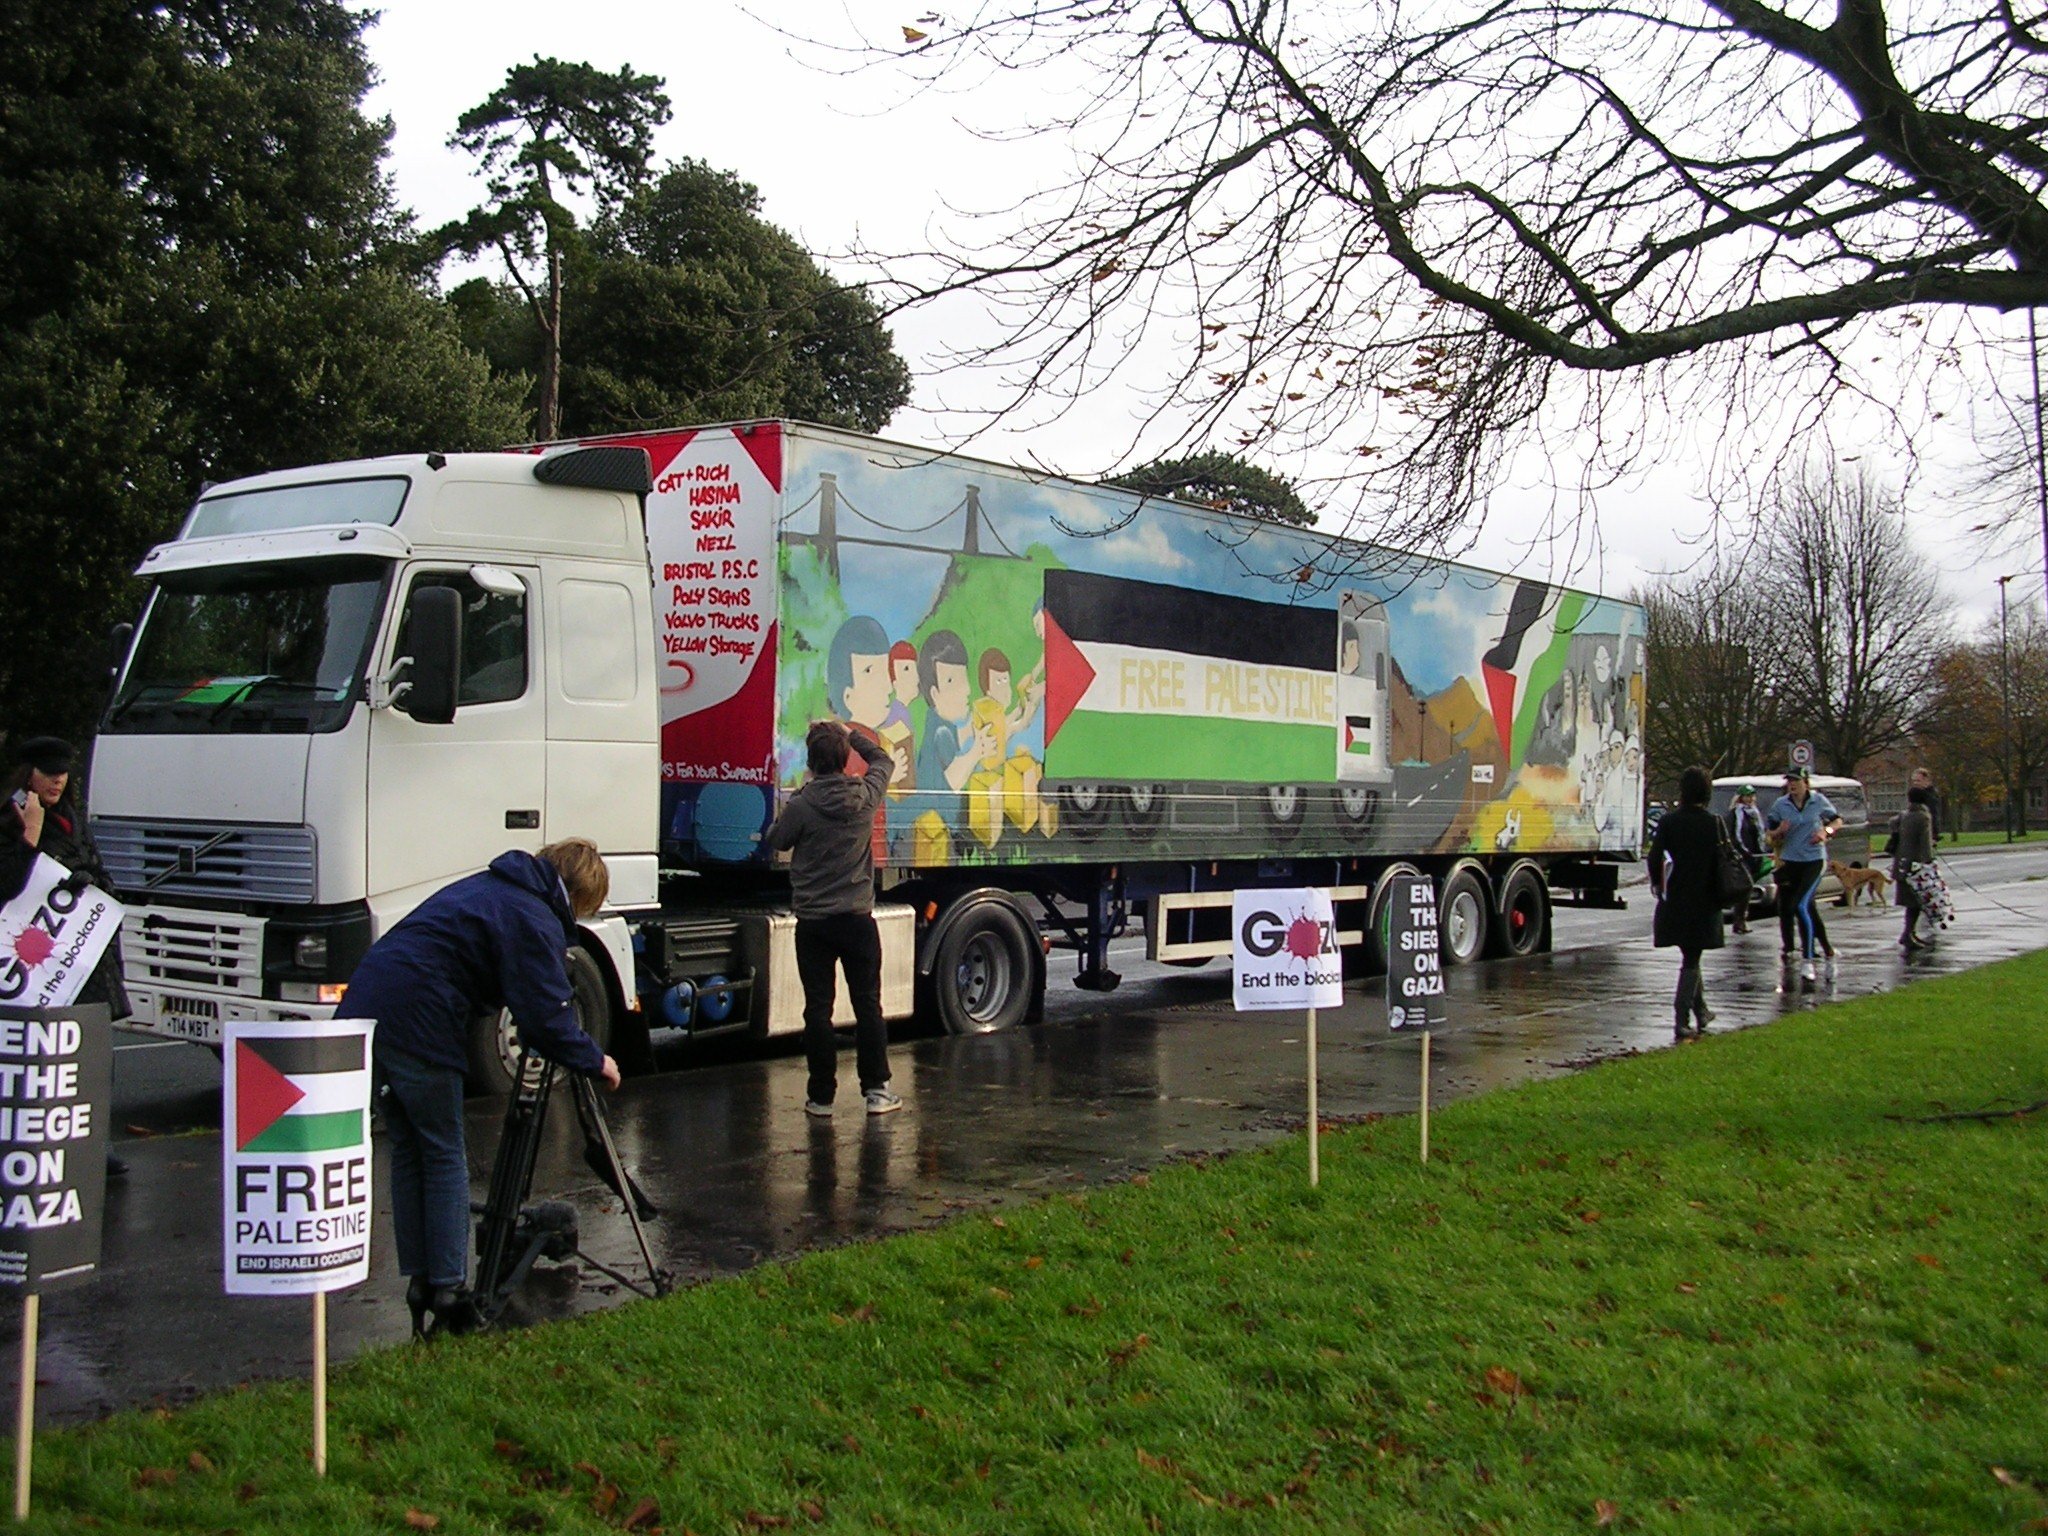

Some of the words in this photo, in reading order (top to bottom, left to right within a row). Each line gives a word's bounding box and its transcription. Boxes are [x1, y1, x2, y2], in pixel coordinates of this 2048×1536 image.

[658, 472, 684, 493] CAT
[695, 463, 729, 482] RICH
[689, 483, 740, 506] HASINA
[696, 534, 736, 552] NEIL
[664, 561, 716, 581] BRISTOL
[708, 587, 751, 608] SIGNS
[664, 611, 706, 629] VOLVO
[708, 612, 759, 632] TRUCKS
[663, 634, 707, 654] YELLOW
[1120, 658, 1186, 708] FREE
[1205, 662, 1334, 722] PALESTINE
[1410, 884, 1435, 903] EN
[1409, 906, 1438, 926] TH
[45, 969, 66, 993] the
[60, 902, 107, 969] blockade
[1401, 930, 1438, 950] SIEG
[1414, 953, 1439, 973] ON
[1242, 972, 1270, 988] End
[1275, 972, 1299, 987] the
[1402, 975, 1445, 997] GAZA
[0, 1020, 82, 1056] END
[0, 1063, 79, 1099] THE
[0, 1103, 91, 1142] IEGE
[3, 1149, 65, 1185] ON
[236, 1157, 366, 1213] FREE
[0, 1189, 82, 1228] AZA
[236, 1211, 365, 1244] PALESTINE
[240, 1257, 266, 1270] END
[269, 1256, 318, 1270] ISRAELI
